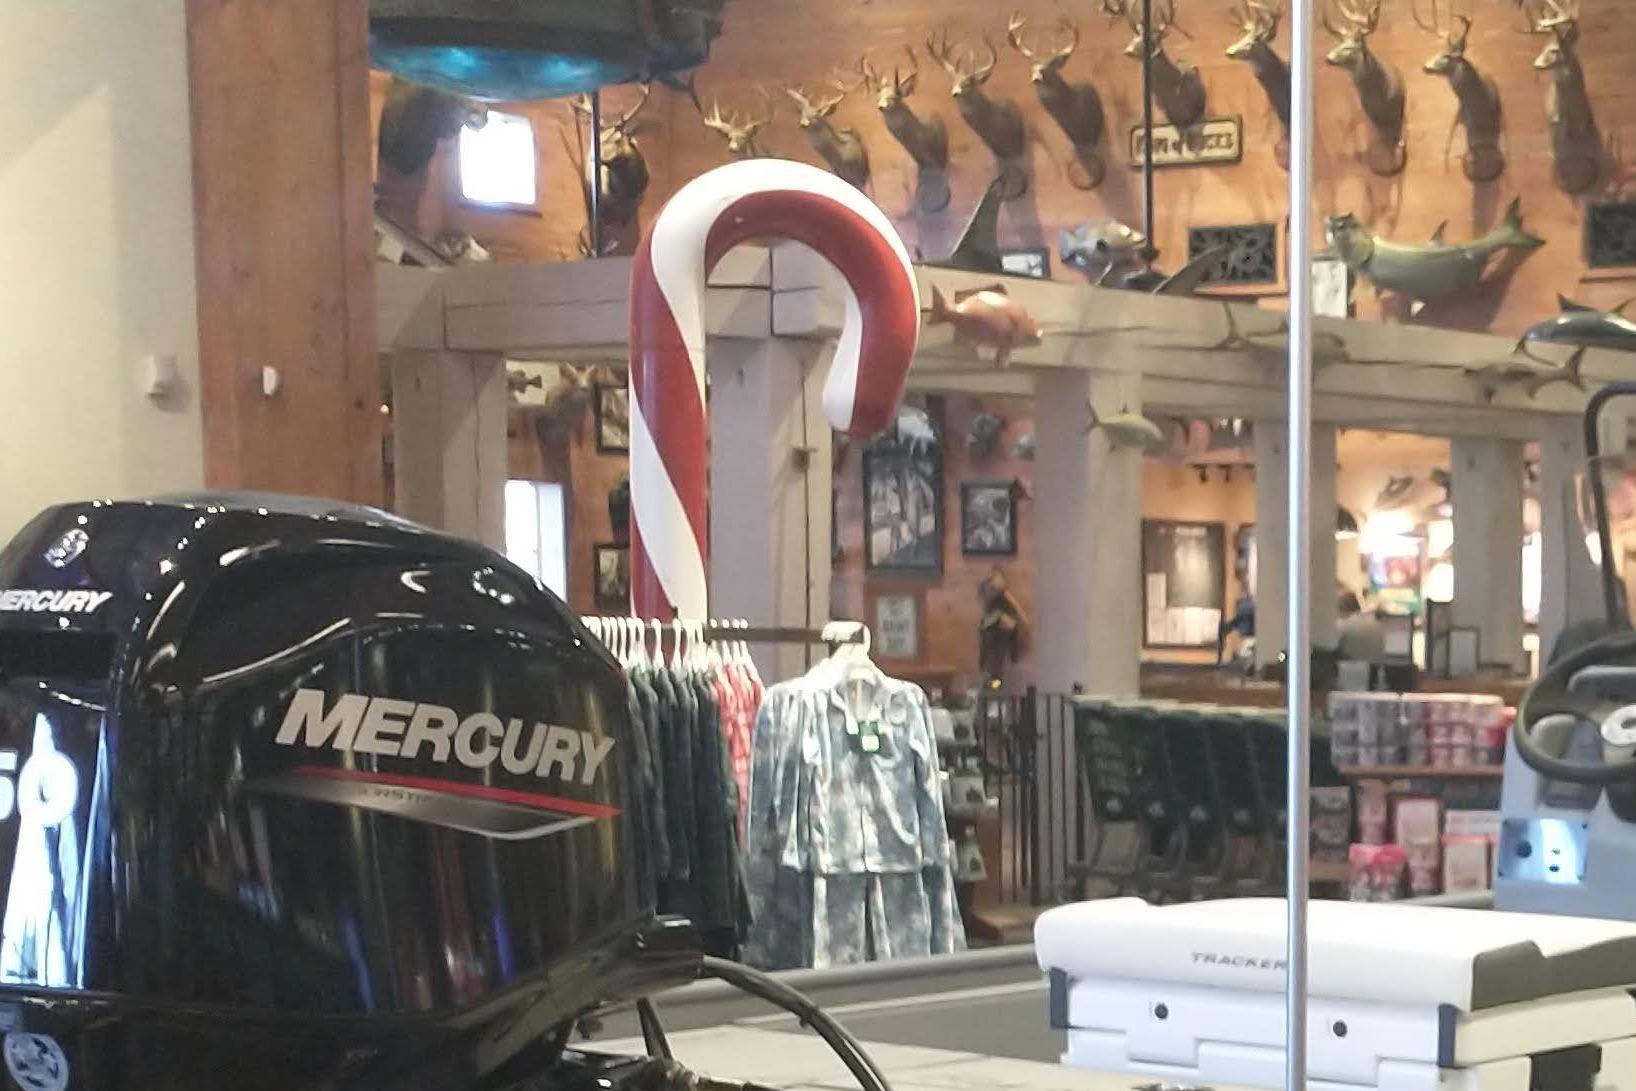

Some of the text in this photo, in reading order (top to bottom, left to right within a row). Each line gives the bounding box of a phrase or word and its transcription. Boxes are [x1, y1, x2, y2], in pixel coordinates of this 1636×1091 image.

[0, 589, 114, 612] ERCURY
[275, 688, 616, 785] MERCURY
[1191, 951, 1288, 969] TRACKER
